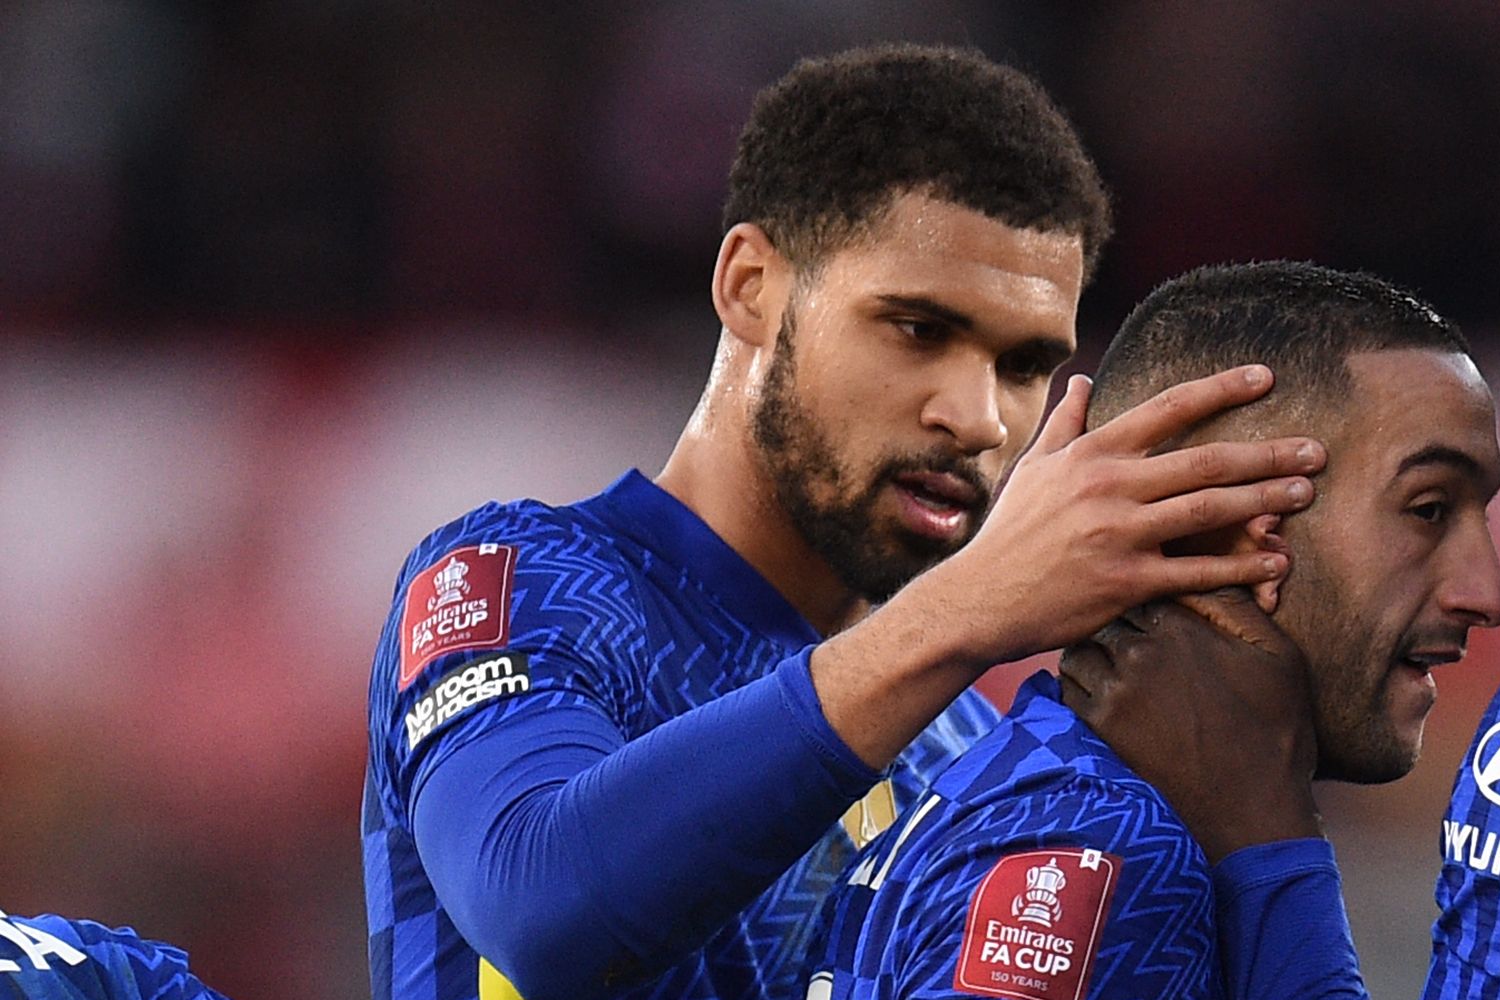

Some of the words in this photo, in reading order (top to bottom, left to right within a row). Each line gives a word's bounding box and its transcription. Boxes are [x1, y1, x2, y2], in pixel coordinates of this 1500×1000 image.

[412, 598, 488, 639] Emirates
[412, 629, 434, 655] FA
[436, 610, 489, 635] CUP
[405, 696, 434, 735] No
[435, 656, 513, 707] room
[436, 674, 529, 726] racism
[0, 909, 88, 971] A
[980, 941, 1011, 966] FA
[1015, 947, 1071, 976] CUP
[985, 919, 1074, 955] Emirates
[991, 970, 1009, 982] 150
[1011, 974, 1049, 992] YEARS
